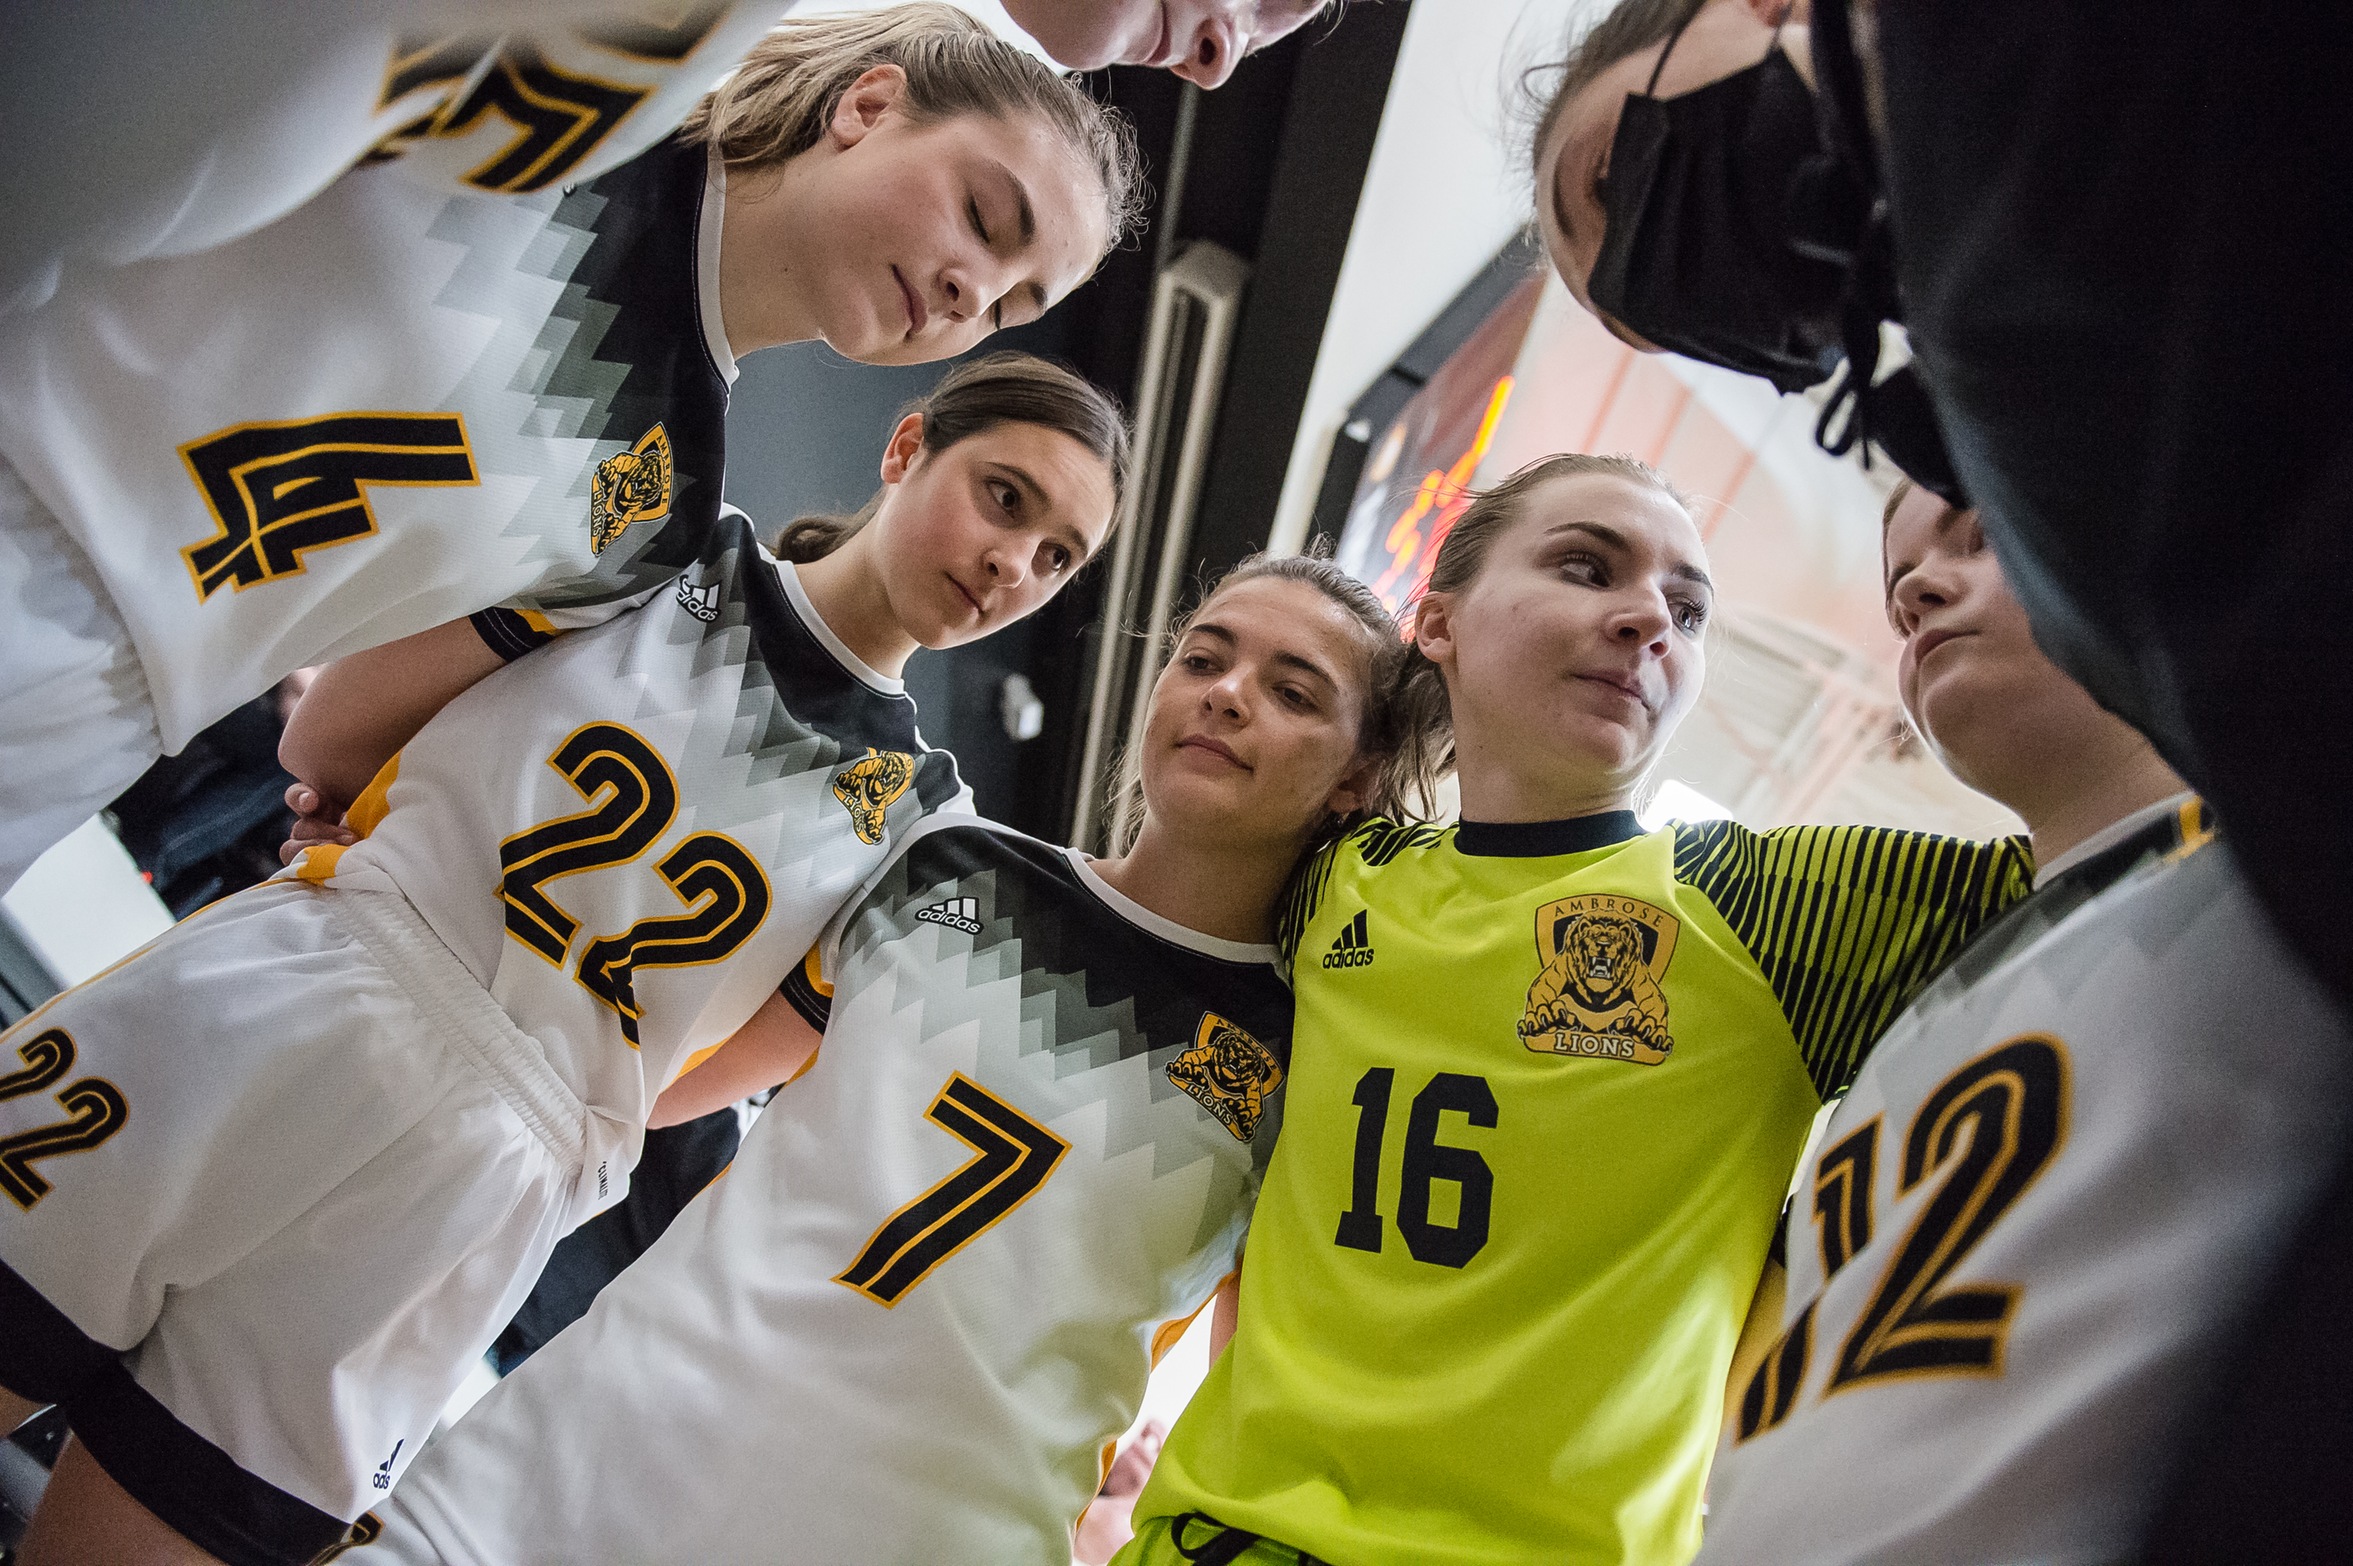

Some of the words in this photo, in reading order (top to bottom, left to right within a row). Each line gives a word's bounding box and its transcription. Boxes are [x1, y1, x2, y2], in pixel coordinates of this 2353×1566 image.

[177, 411, 482, 606] 4
[593, 490, 603, 537] LIONS
[676, 589, 719, 622] didas
[493, 719, 774, 1052] 22
[917, 909, 981, 934] adidas
[1554, 898, 1664, 929] AMBROSE
[1322, 947, 1375, 970] adidas
[1555, 1032, 1636, 1059] LIONS
[1186, 1083, 1234, 1125] LIONS
[829, 1069, 1074, 1311] 7
[1334, 1066, 1500, 1270] 16
[1732, 1029, 2076, 1450] 12
